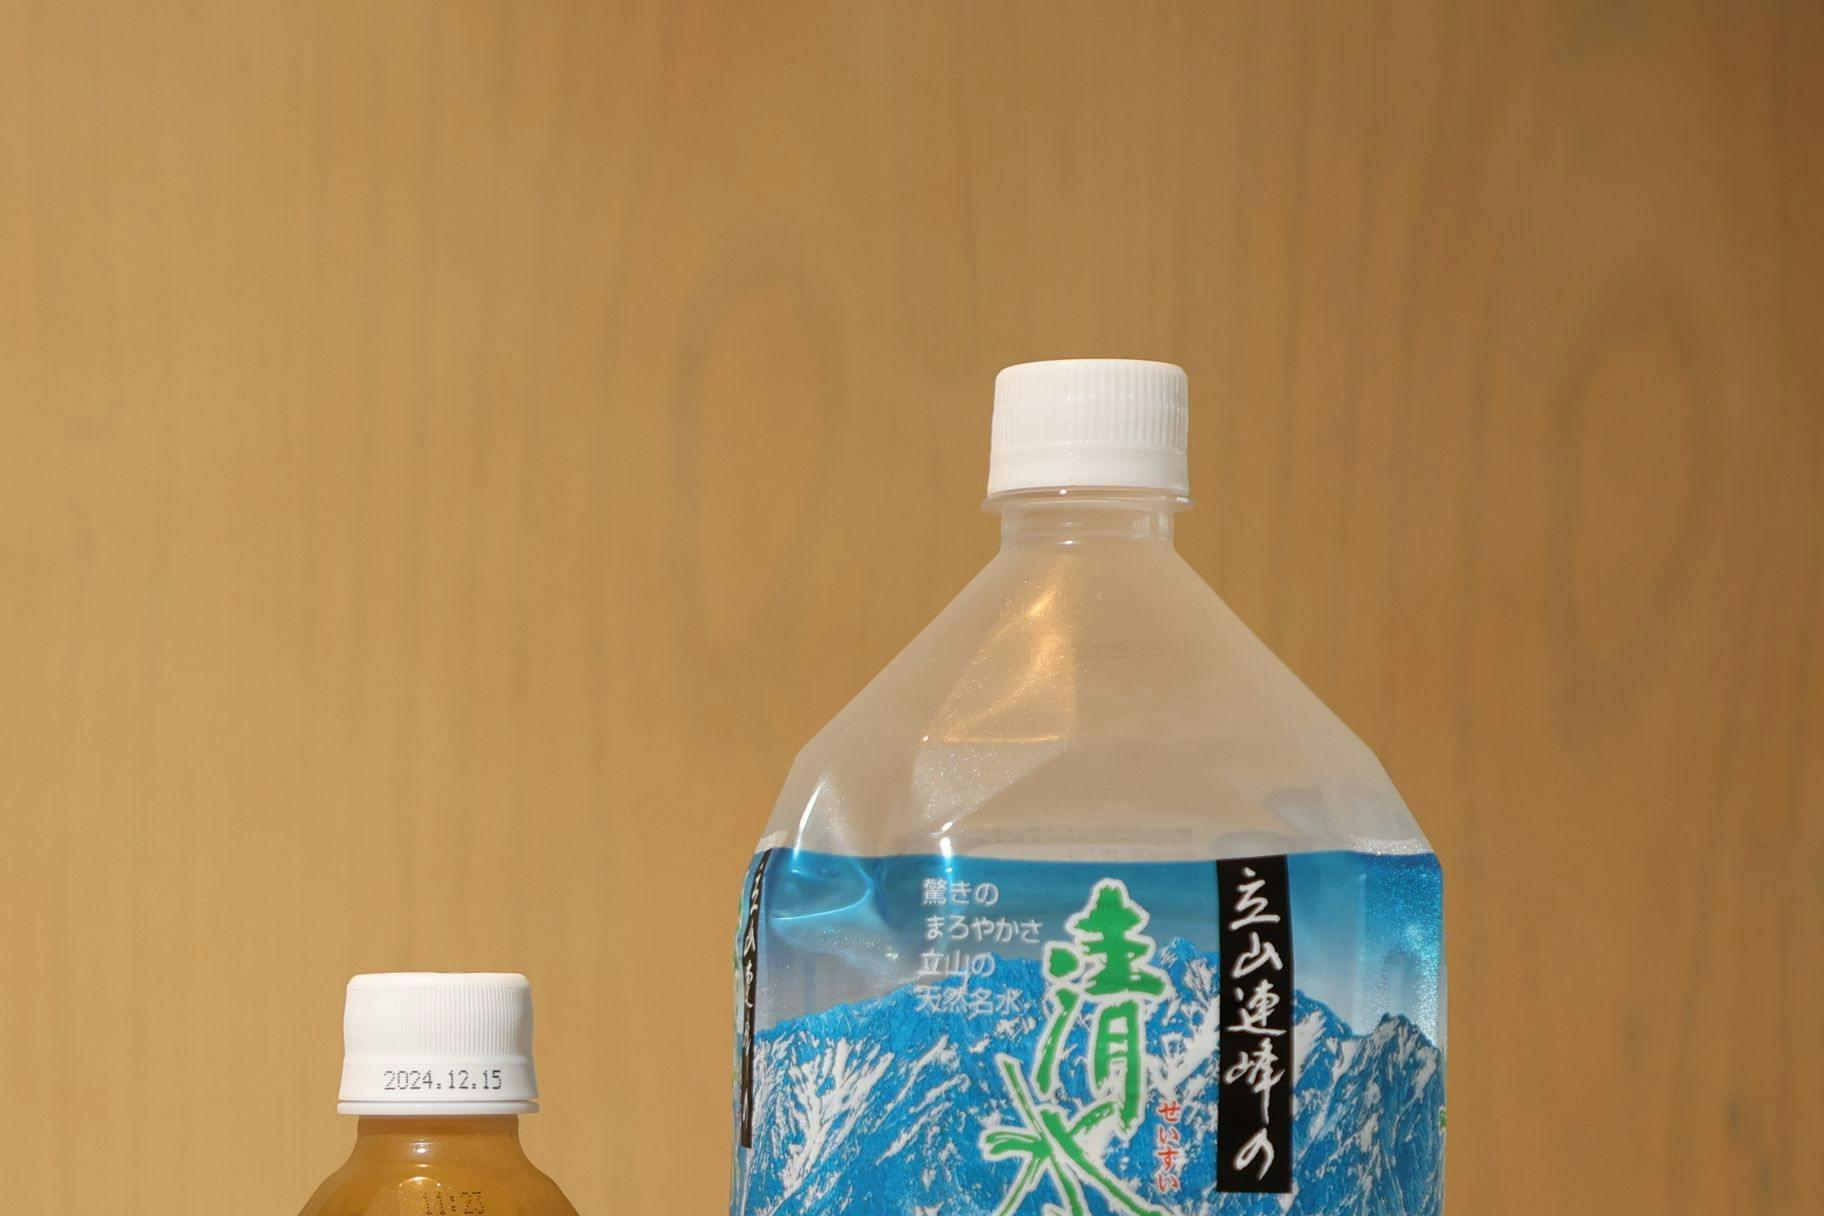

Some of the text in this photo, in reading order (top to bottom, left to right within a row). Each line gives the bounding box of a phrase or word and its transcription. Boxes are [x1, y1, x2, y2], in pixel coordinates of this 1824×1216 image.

[922, 878, 999, 905] 驚きの
[927, 915, 1043, 943] まろやかさ
[919, 949, 996, 977] 立山の
[914, 984, 1023, 1019] 天然名水
[1224, 868, 1288, 1182] 立山連峰の
[384, 1070, 502, 1091] 2024.12.15
[1156, 1102, 1179, 1194] せいすい
